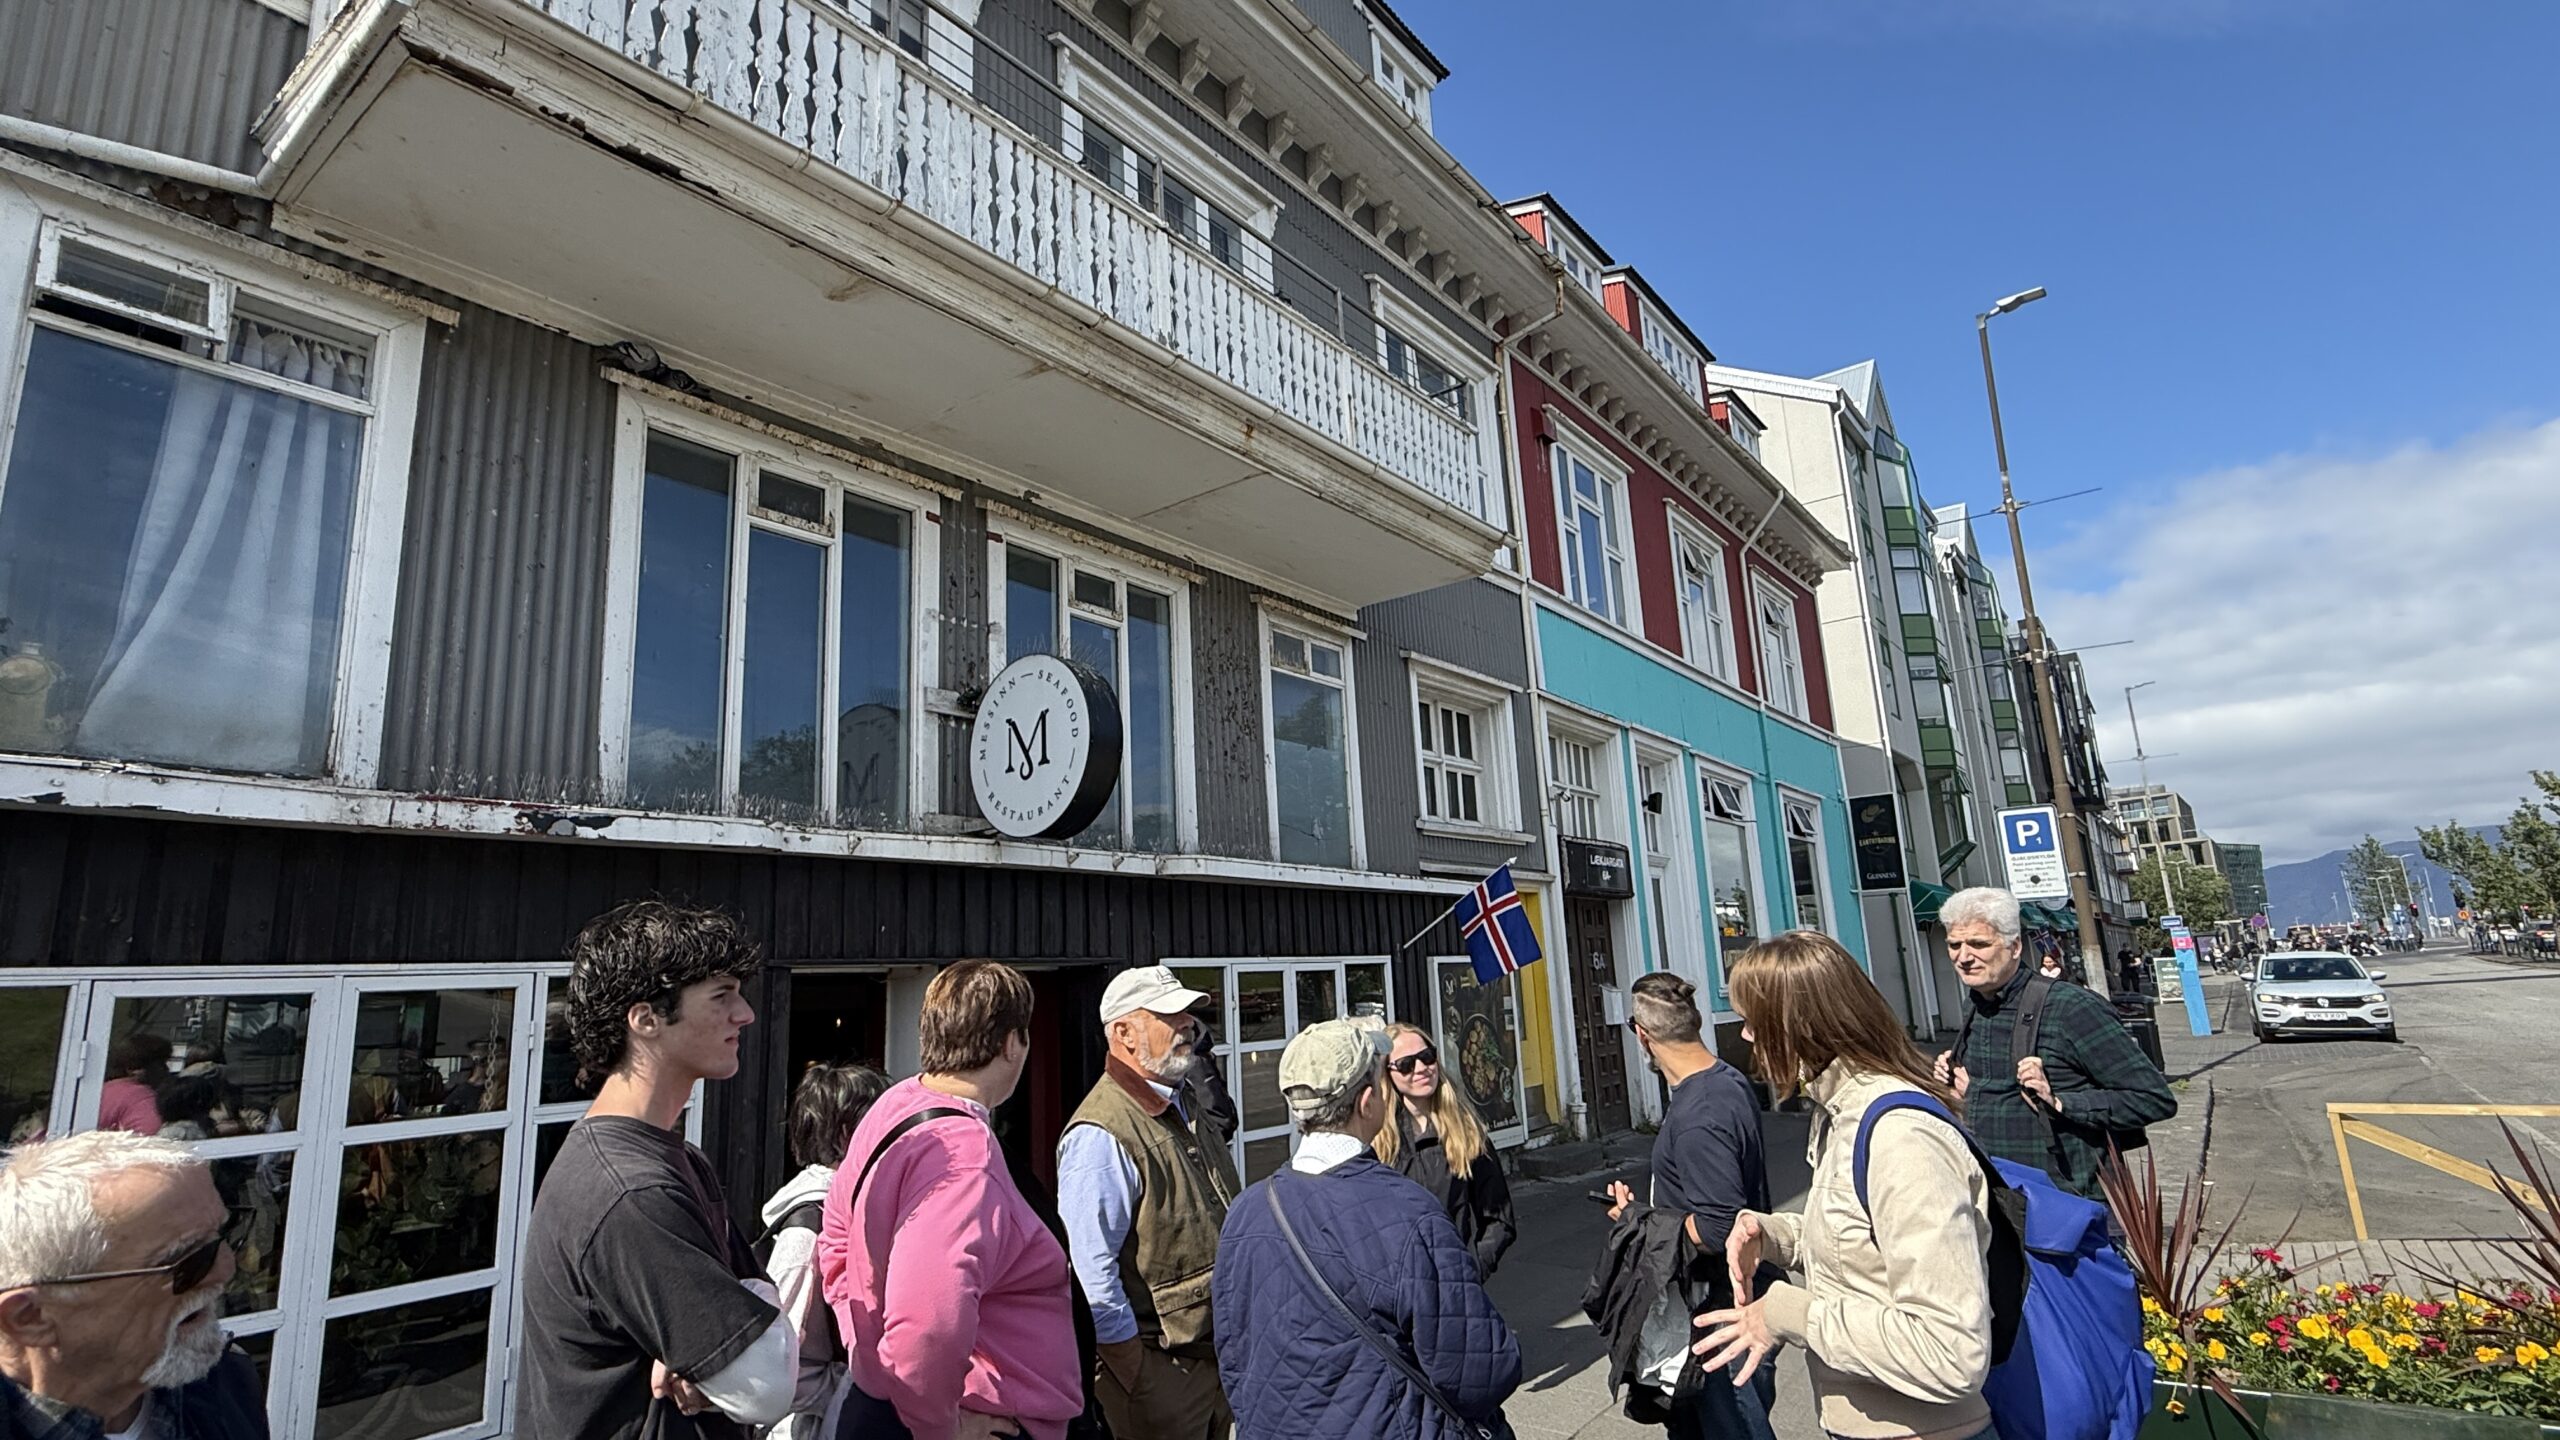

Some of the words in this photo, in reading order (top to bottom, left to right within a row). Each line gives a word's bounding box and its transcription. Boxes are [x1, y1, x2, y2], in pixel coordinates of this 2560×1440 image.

[979, 677, 1017, 761] MESSINN
[1037, 669, 1080, 739] SEAFOOD
[987, 774, 1071, 822] RESTAURANT
[2016, 819, 2040, 847] P
[1867, 872, 1896, 880] GUINNESS
[1593, 952, 1605, 970] 6A
